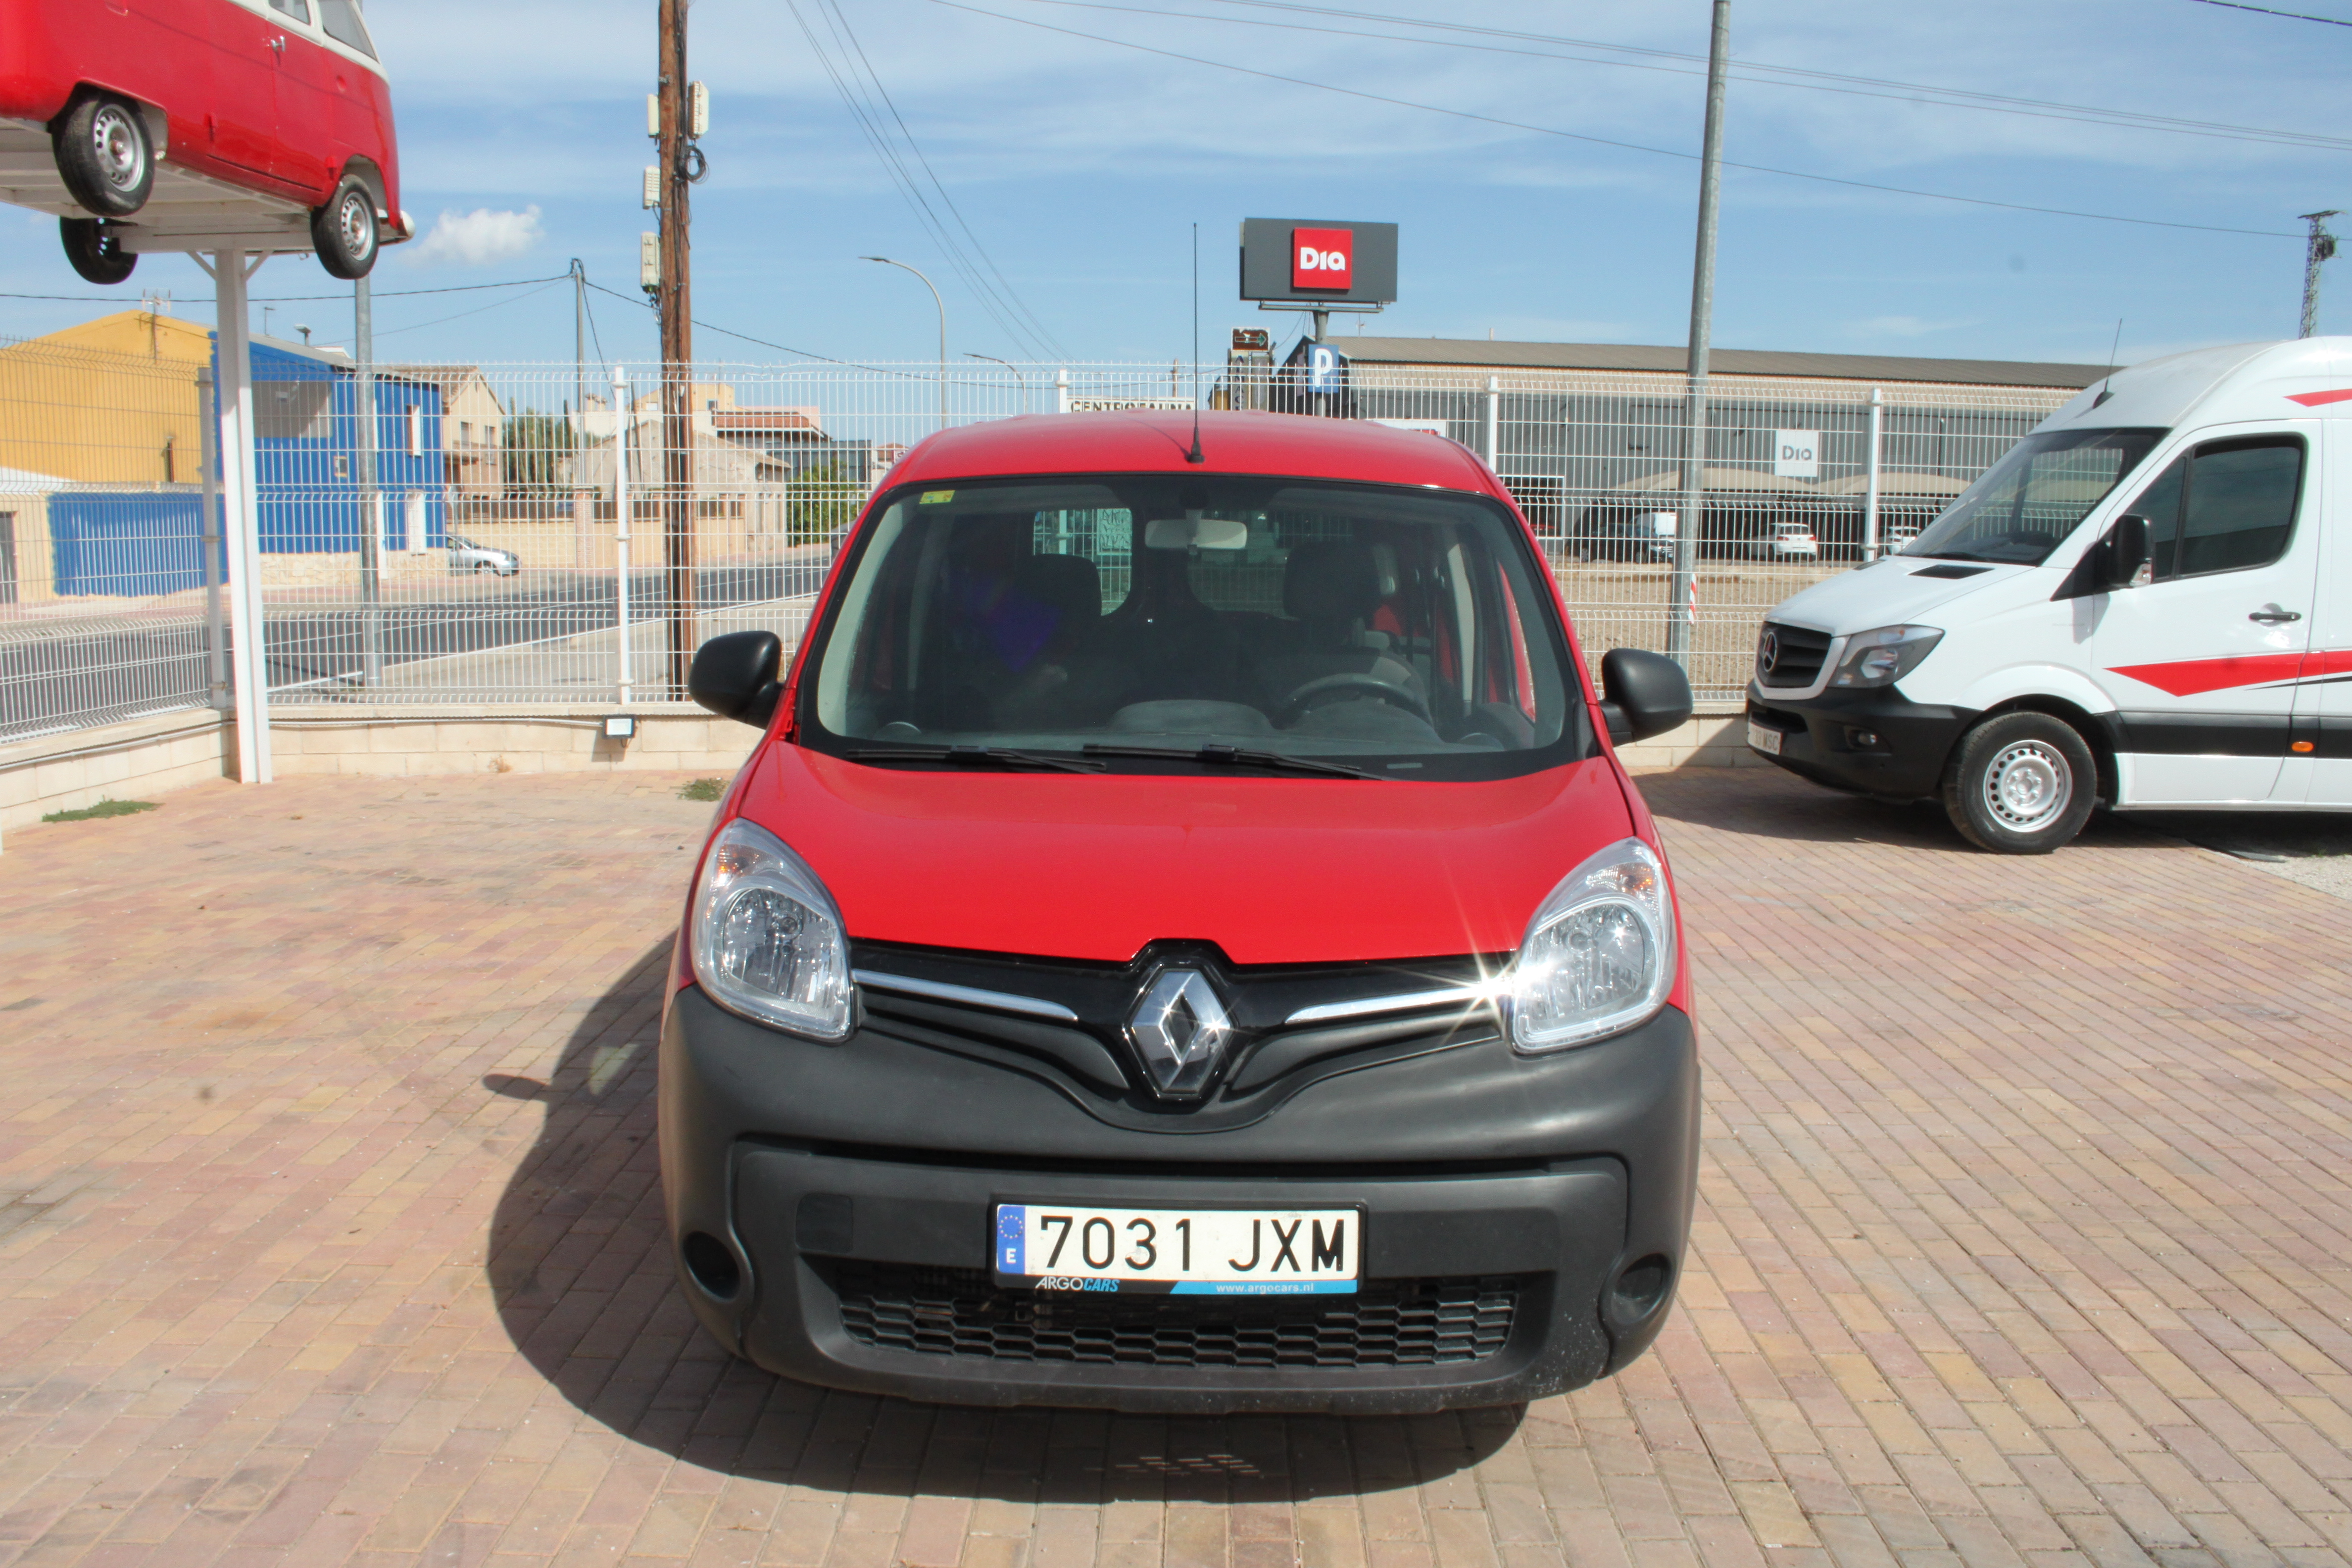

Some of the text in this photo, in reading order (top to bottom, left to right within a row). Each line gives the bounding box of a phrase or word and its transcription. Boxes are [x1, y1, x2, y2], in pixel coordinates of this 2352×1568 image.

[1315, 348, 1333, 388] P
[1006, 1248, 1017, 1263] E
[1041, 1215, 1344, 1272] 7031 JXM
[1216, 1283, 1314, 1295] www.argocars.nl
